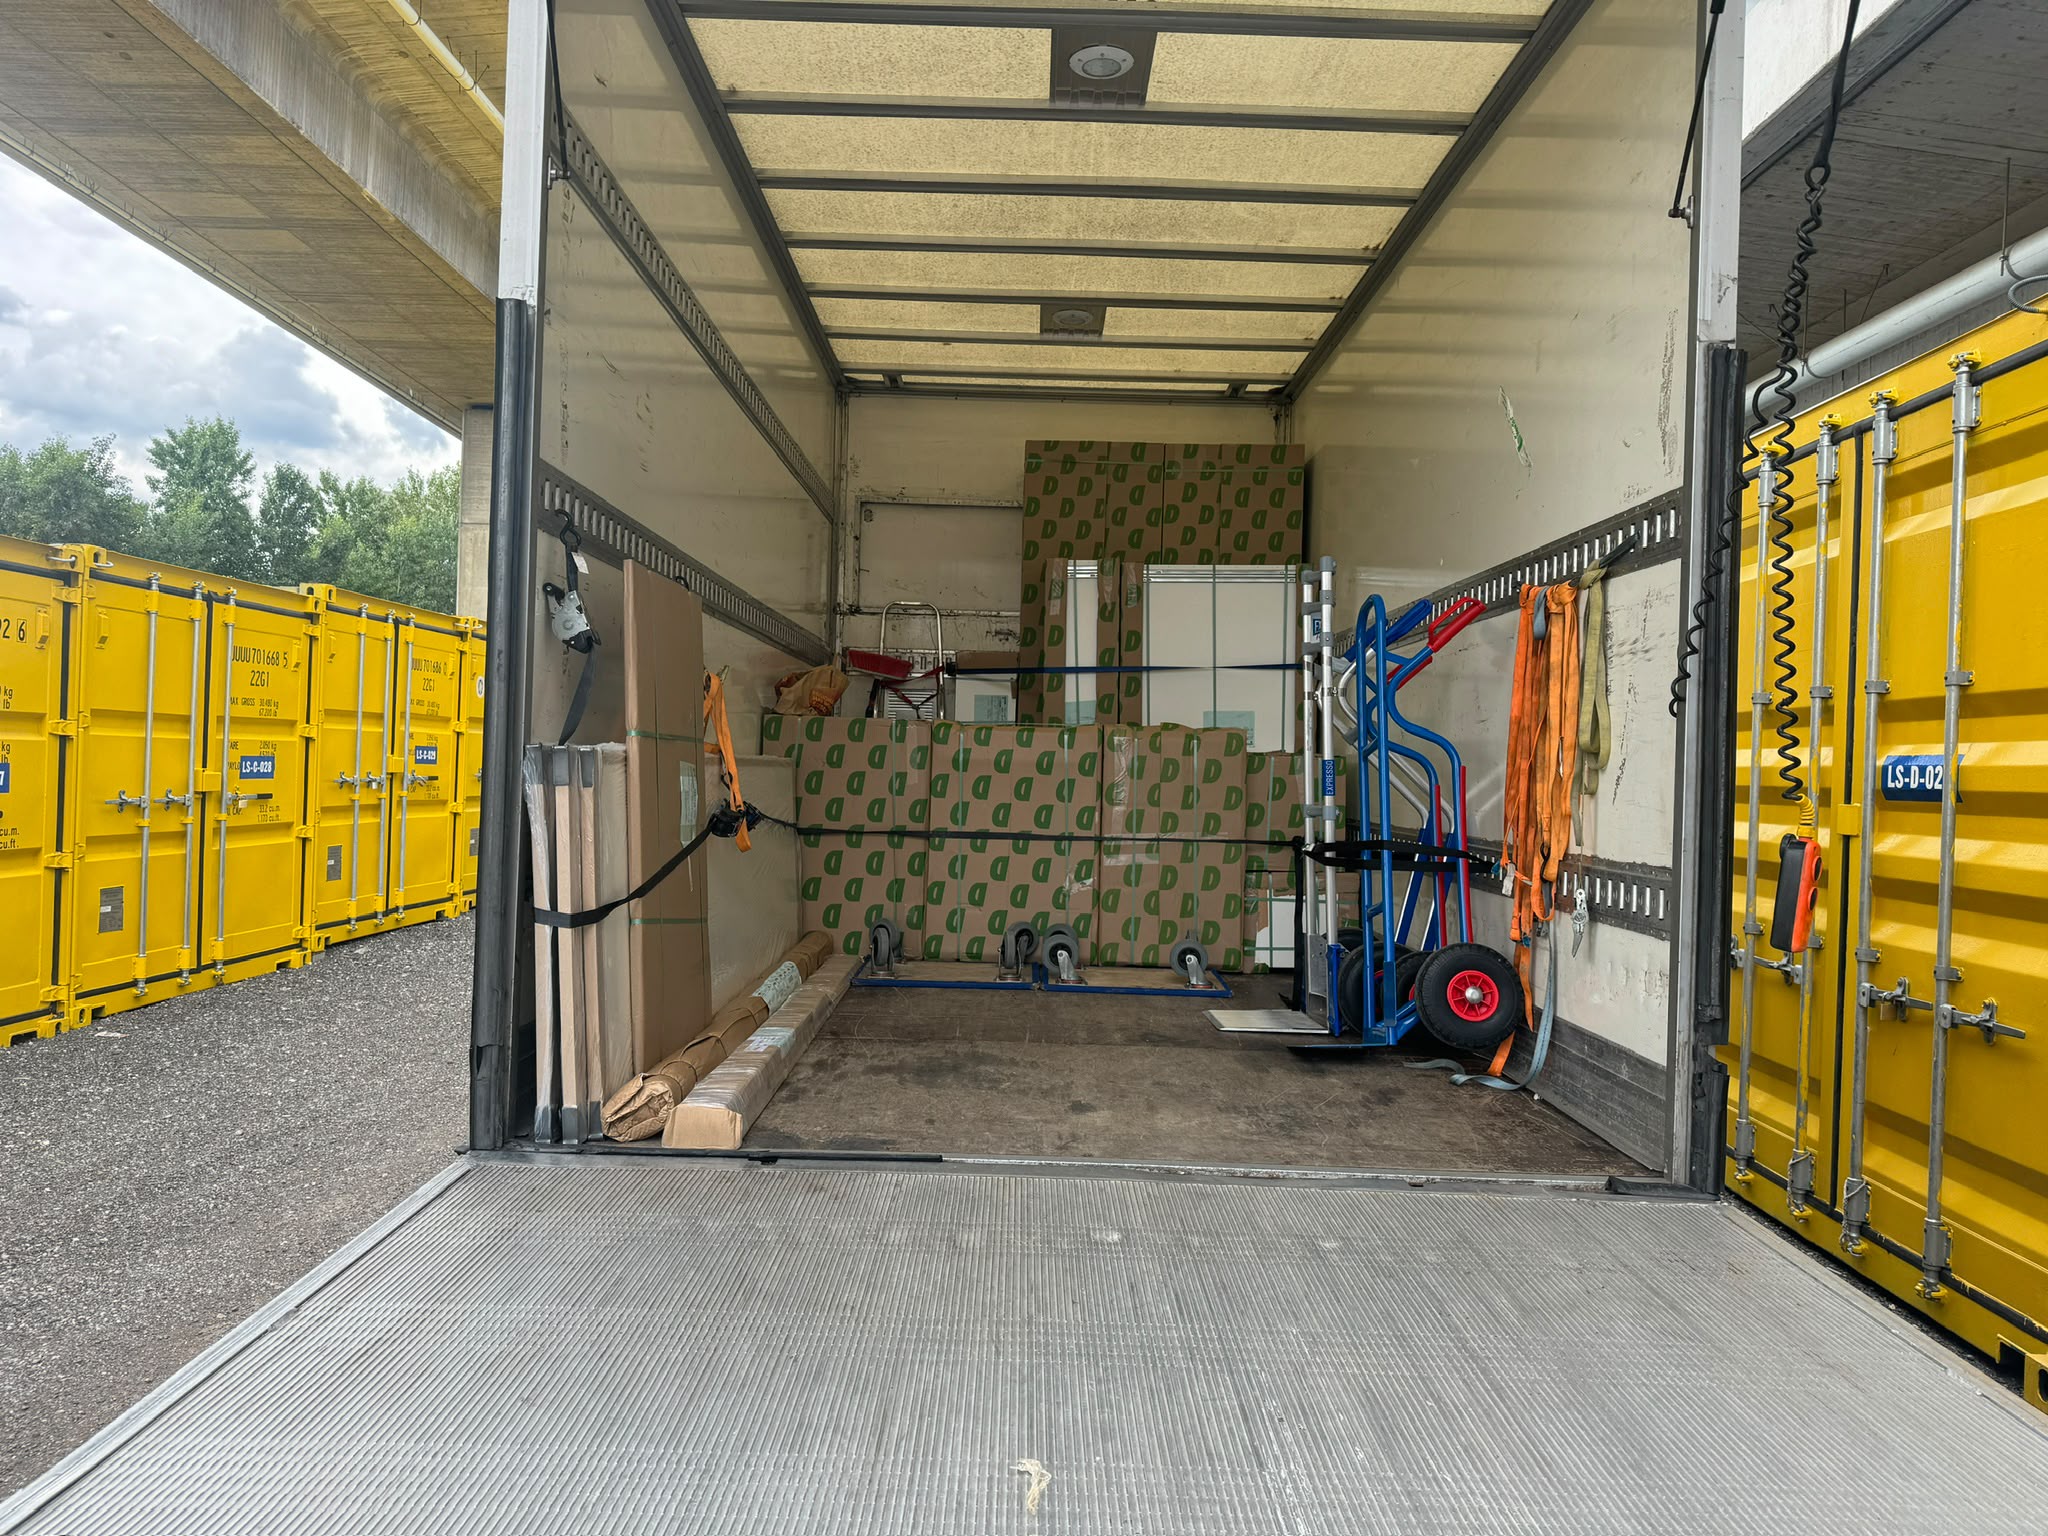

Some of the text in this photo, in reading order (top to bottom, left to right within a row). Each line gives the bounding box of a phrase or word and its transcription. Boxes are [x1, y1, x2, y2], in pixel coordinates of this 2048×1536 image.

[18, 621, 26, 641] 6
[250, 670, 270, 688] 22G1
[4, 686, 13, 699] kg
[3, 699, 11, 710] lb
[2, 742, 11, 755] kg
[242, 761, 272, 773] LS-C-028
[1325, 760, 1334, 795] EXPRESSO
[1887, 765, 1943, 790] LS-D-02
